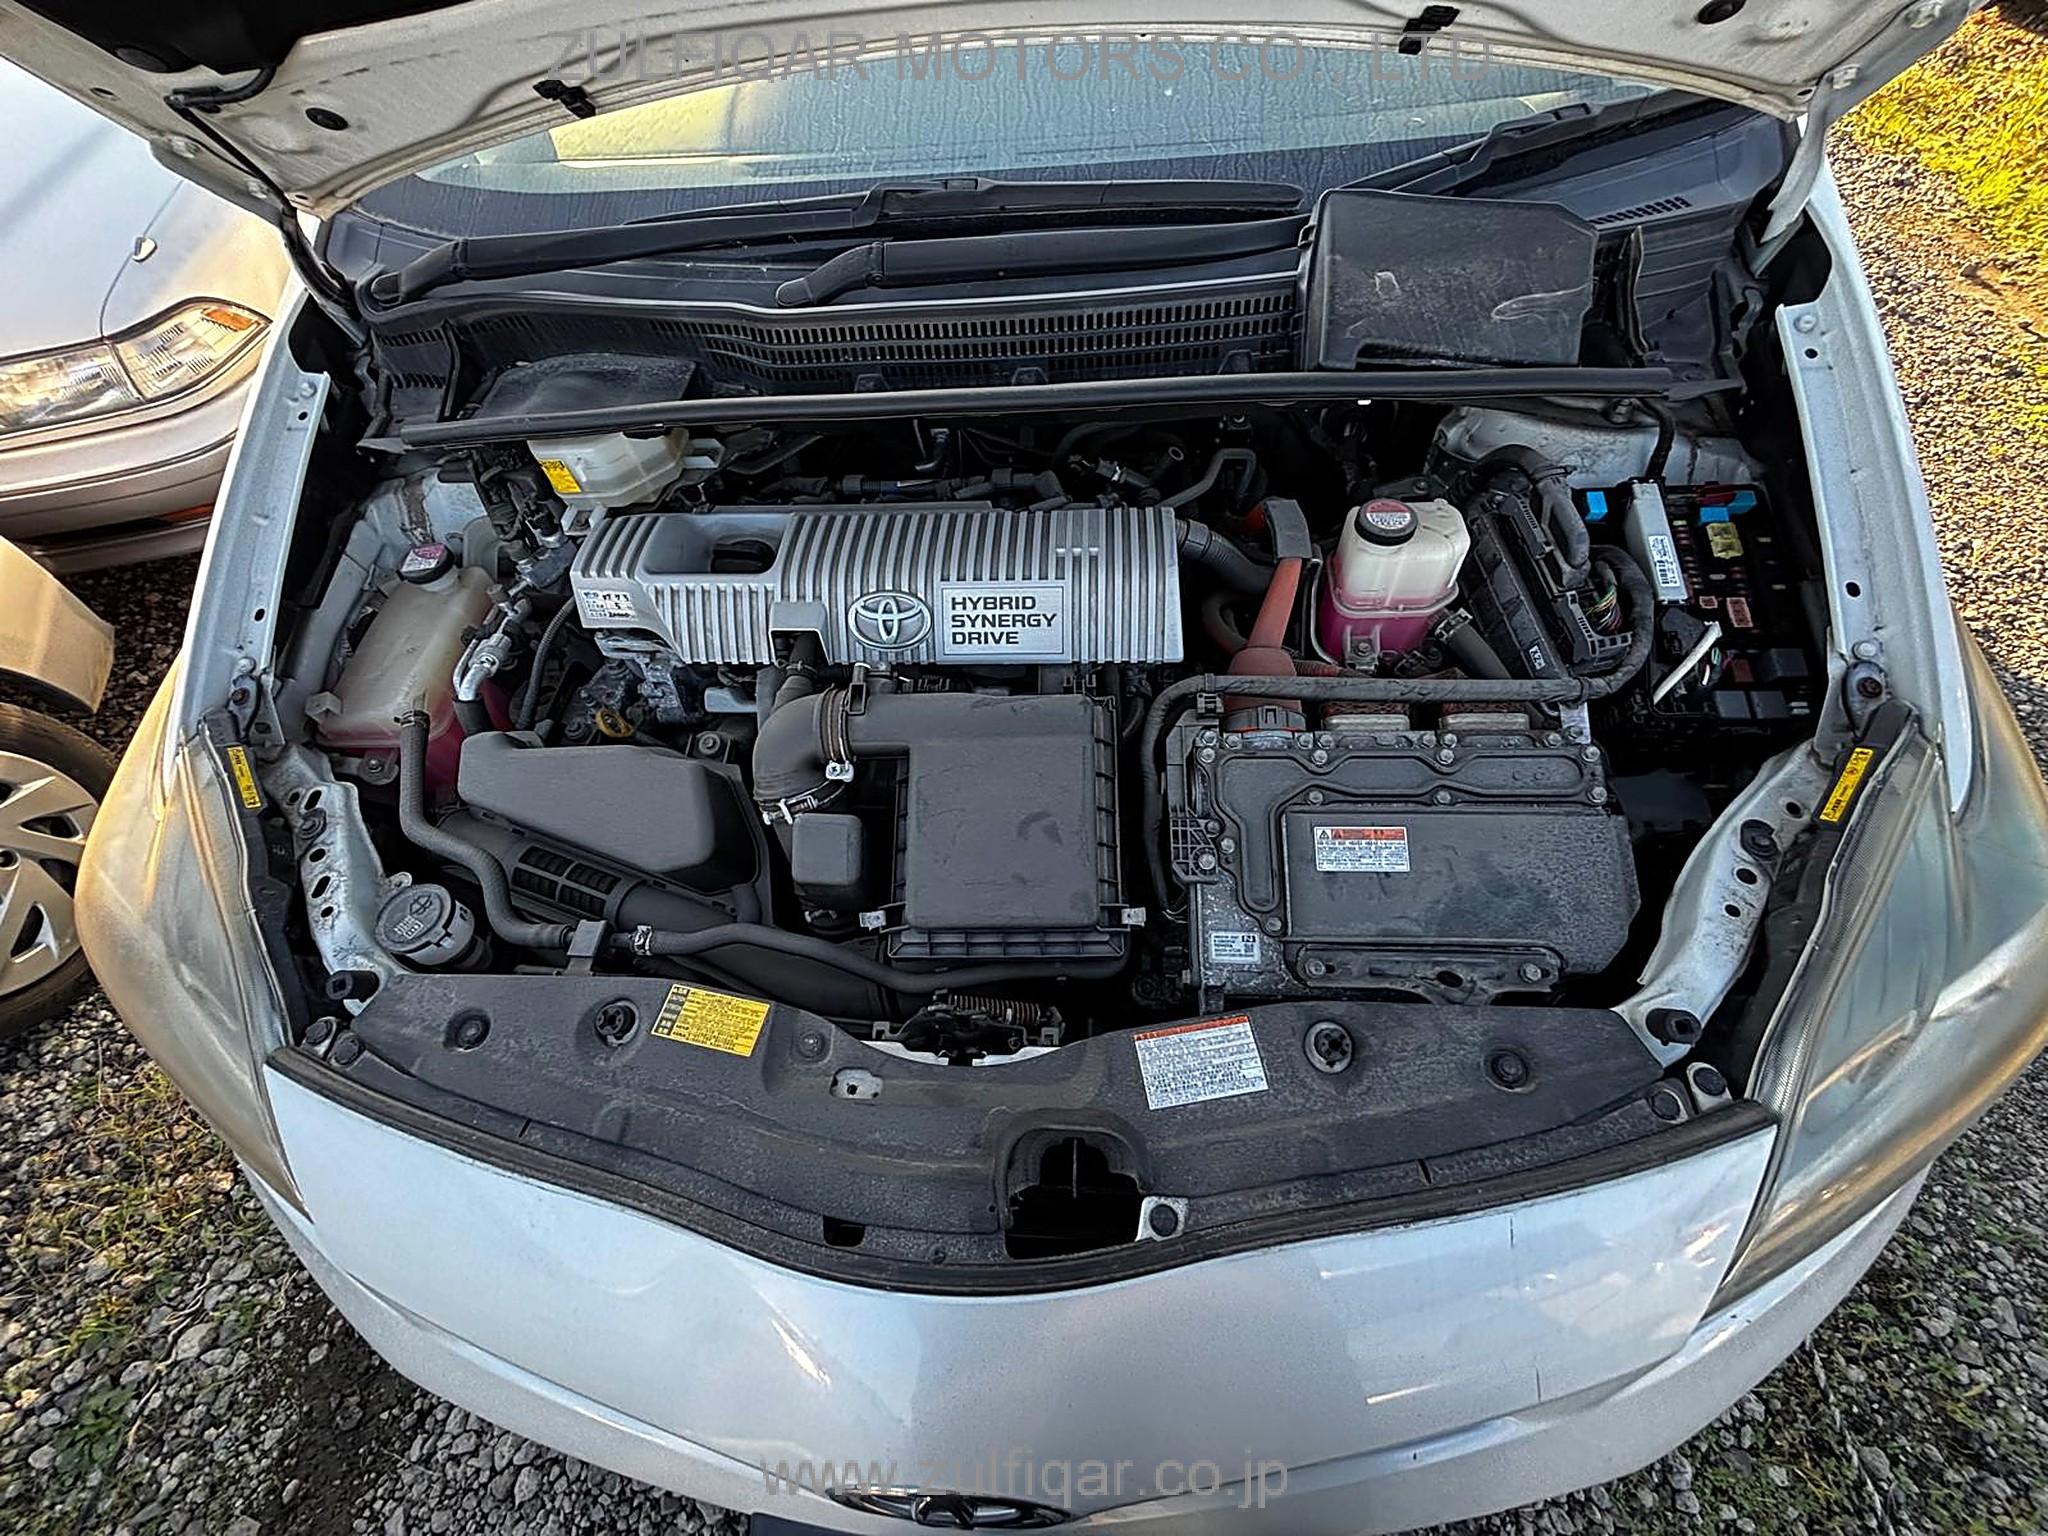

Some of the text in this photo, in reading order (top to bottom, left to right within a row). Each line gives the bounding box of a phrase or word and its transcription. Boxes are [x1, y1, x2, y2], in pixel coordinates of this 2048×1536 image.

[951, 596, 1036, 611] HYBRID
[951, 613, 1057, 628] SYNERGY
[952, 631, 1019, 645] DRIVE
